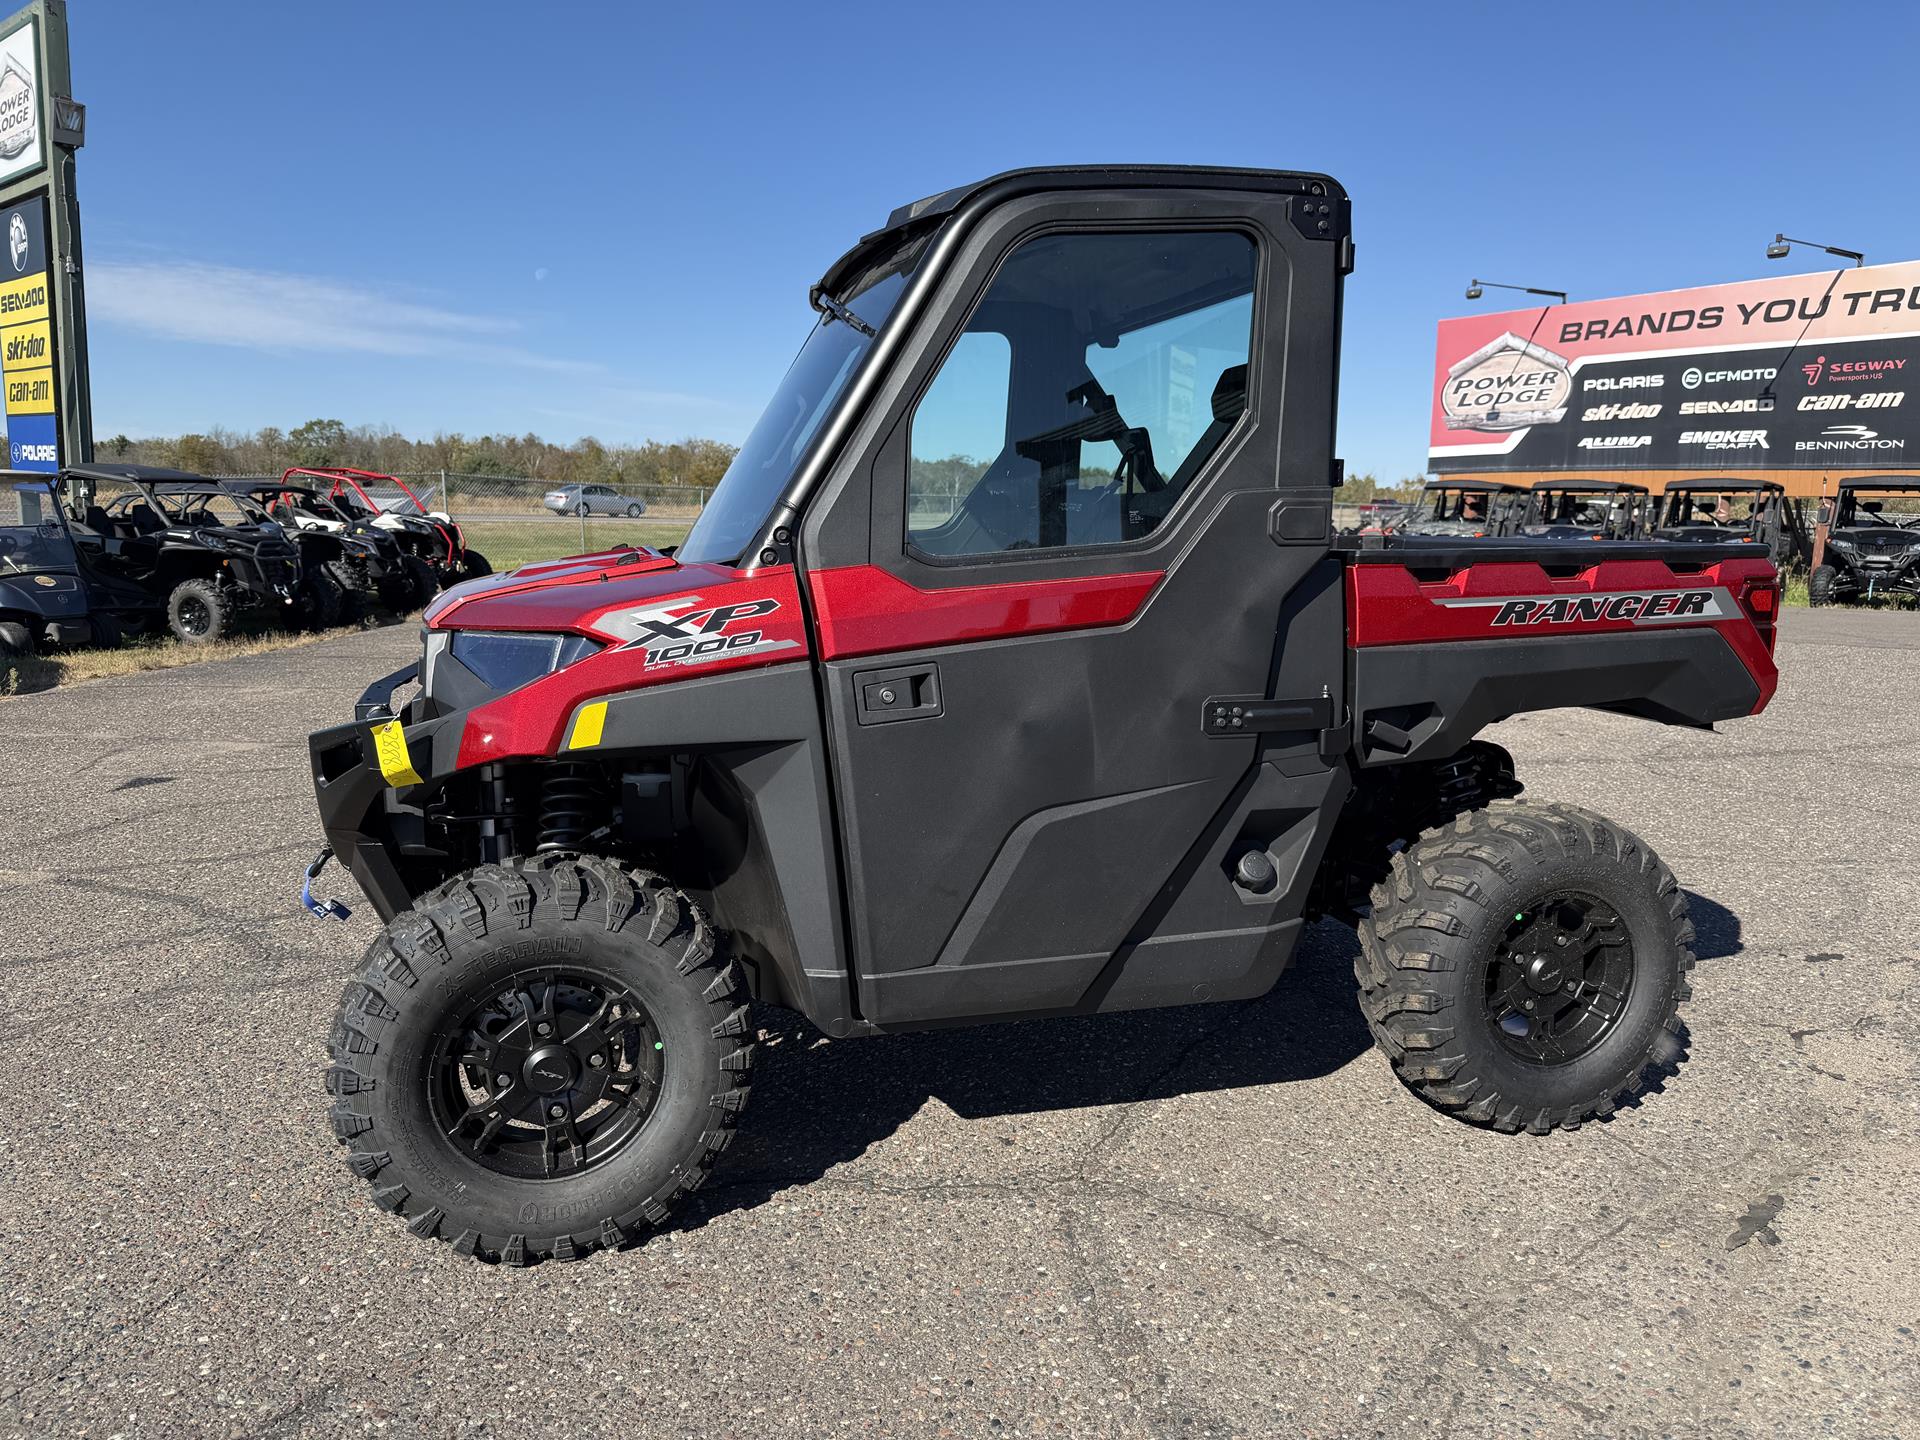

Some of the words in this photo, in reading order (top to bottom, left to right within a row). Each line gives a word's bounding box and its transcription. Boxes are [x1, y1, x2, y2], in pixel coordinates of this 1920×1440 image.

[0, 88, 29, 115] OWER
[0, 106, 29, 133] ODGE
[1559, 306, 1724, 343] BRANDS
[1736, 295, 1832, 325] YOU
[7, 333, 45, 361] ski-doo
[1704, 367, 1777, 383] CFMOTO
[1830, 359, 1907, 373] SEGWAY
[9, 379, 49, 402] can-am
[1453, 371, 1559, 395] POWER
[1583, 374, 1664, 392] POLARIS
[1457, 388, 1553, 408] LODGE
[1581, 402, 1663, 422] ski-doo
[1577, 435, 1652, 449] ALUMA
[1678, 429, 1770, 449] SMOKER
[1705, 442, 1757, 450] CRAFT
[1795, 439, 1905, 451] BENNINGTON
[22, 445, 56, 461] POLARIS
[1490, 590, 1715, 627] RANGER
[608, 598, 781, 654] XP
[644, 629, 763, 667] 1000
[645, 662, 672, 672] DUAL
[674, 651, 730, 666] OVERHEAD
[733, 646, 756, 655] CAM
